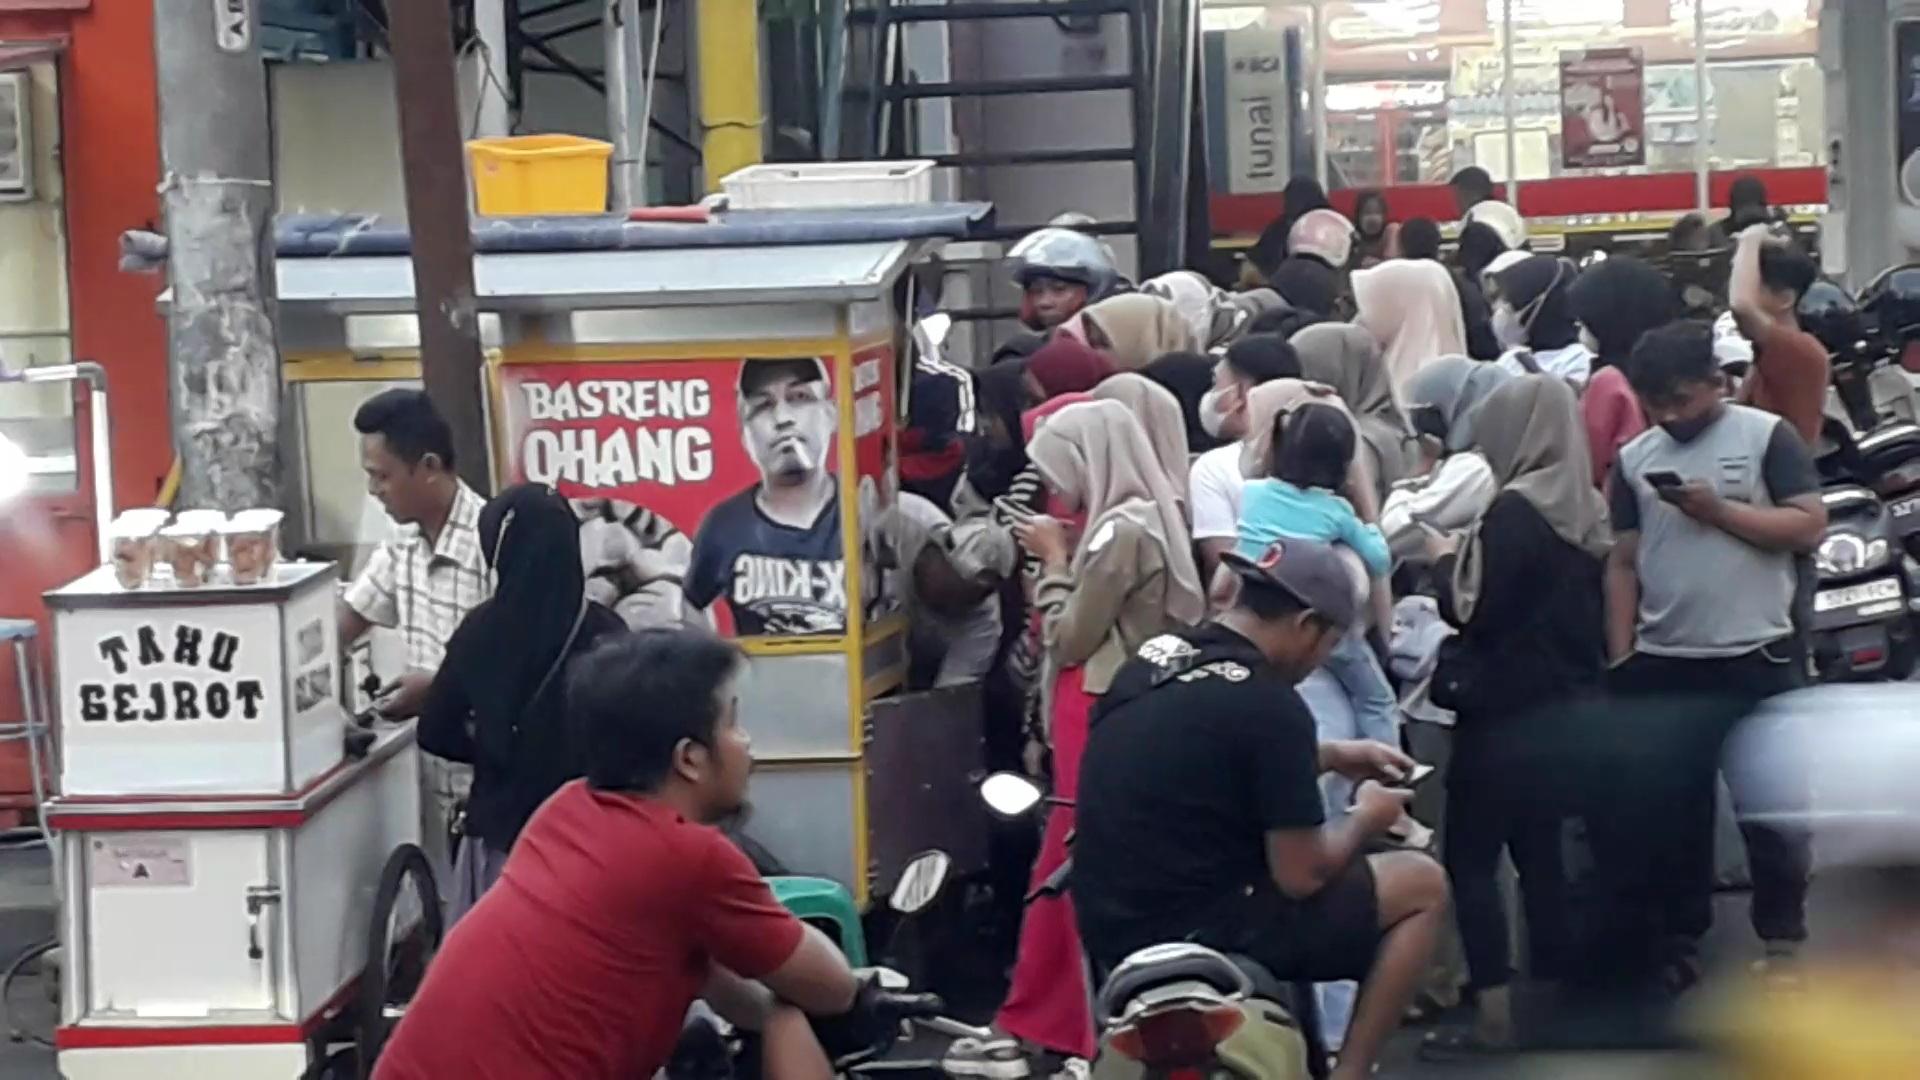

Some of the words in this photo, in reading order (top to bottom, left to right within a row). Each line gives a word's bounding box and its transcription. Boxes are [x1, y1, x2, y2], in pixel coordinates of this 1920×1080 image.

[521, 378, 711, 420] BASRENG
[99, 625, 240, 674] TAHU
[79, 680, 264, 722] GEJROT
